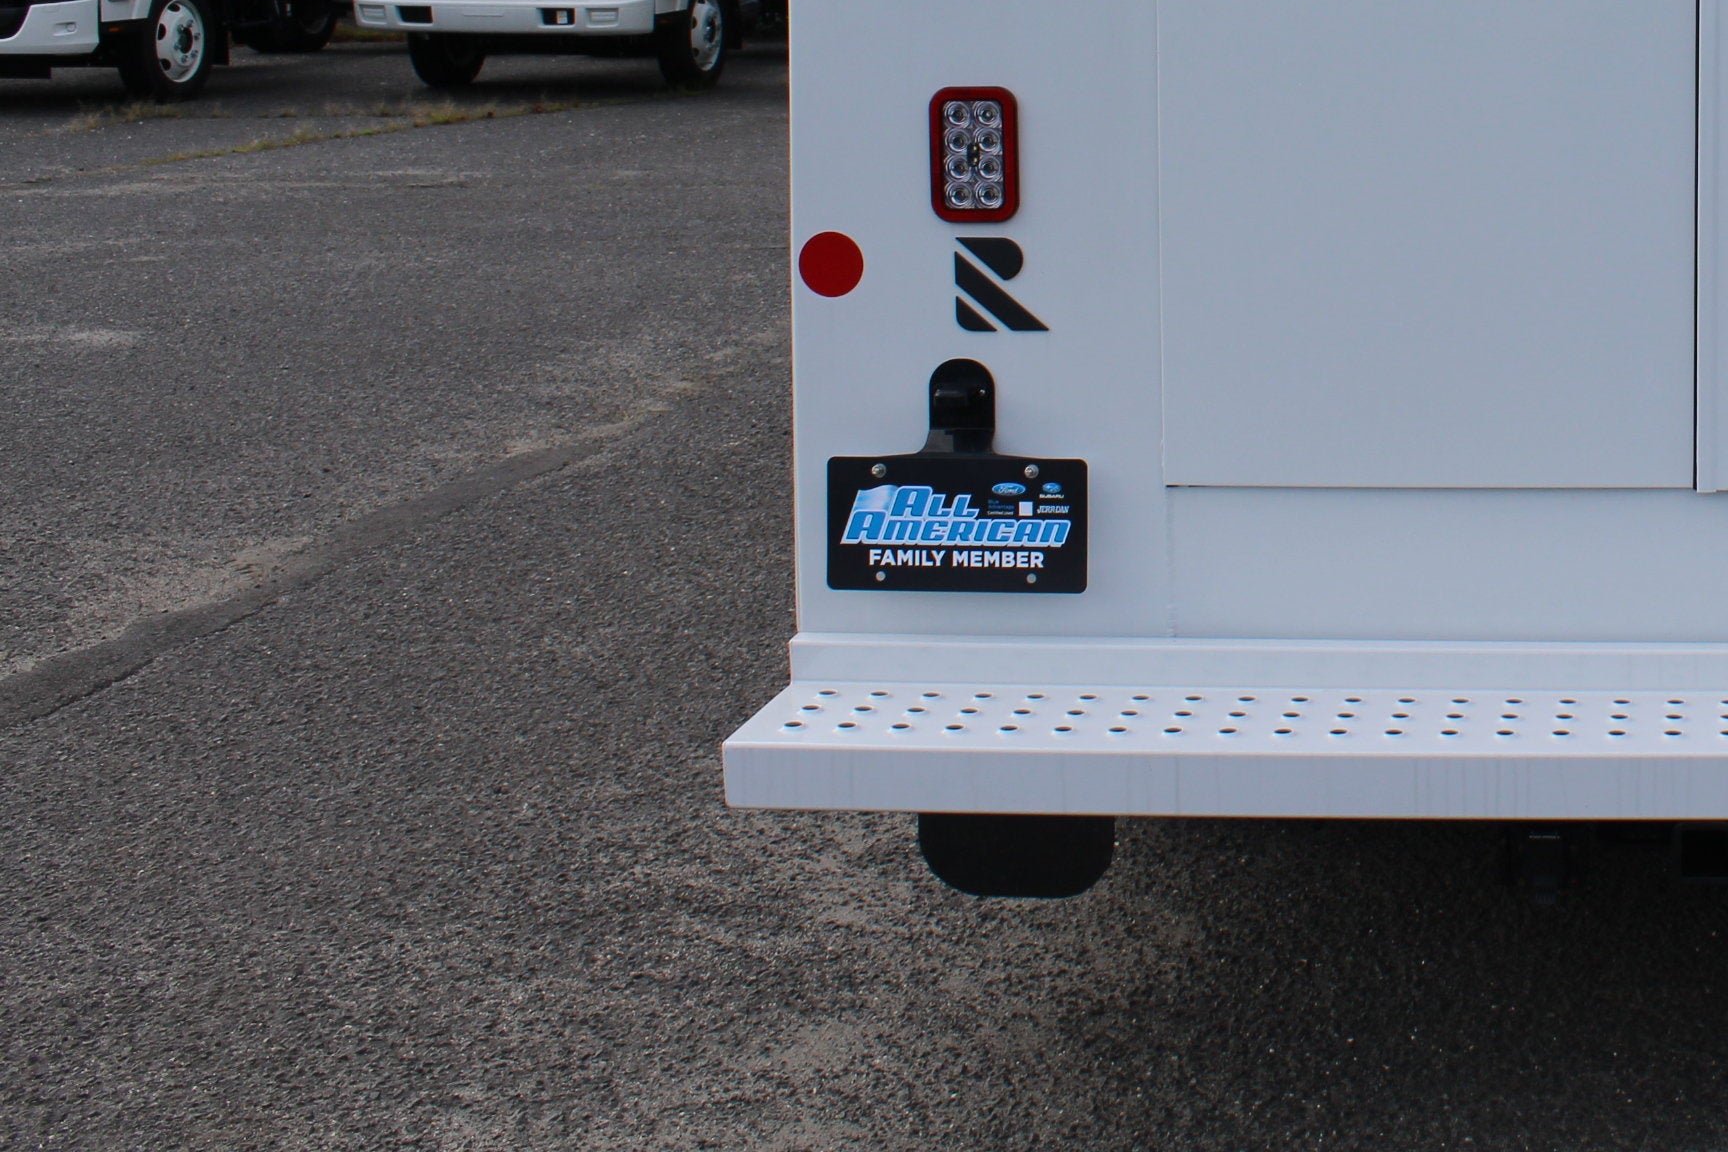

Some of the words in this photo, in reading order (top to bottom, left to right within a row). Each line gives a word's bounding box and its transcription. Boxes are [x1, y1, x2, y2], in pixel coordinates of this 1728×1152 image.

[889, 485, 981, 519] ALL
[841, 510, 1072, 547] AMERICAN
[868, 549, 946, 566] FAMILY
[952, 551, 1044, 568] MEMBER
